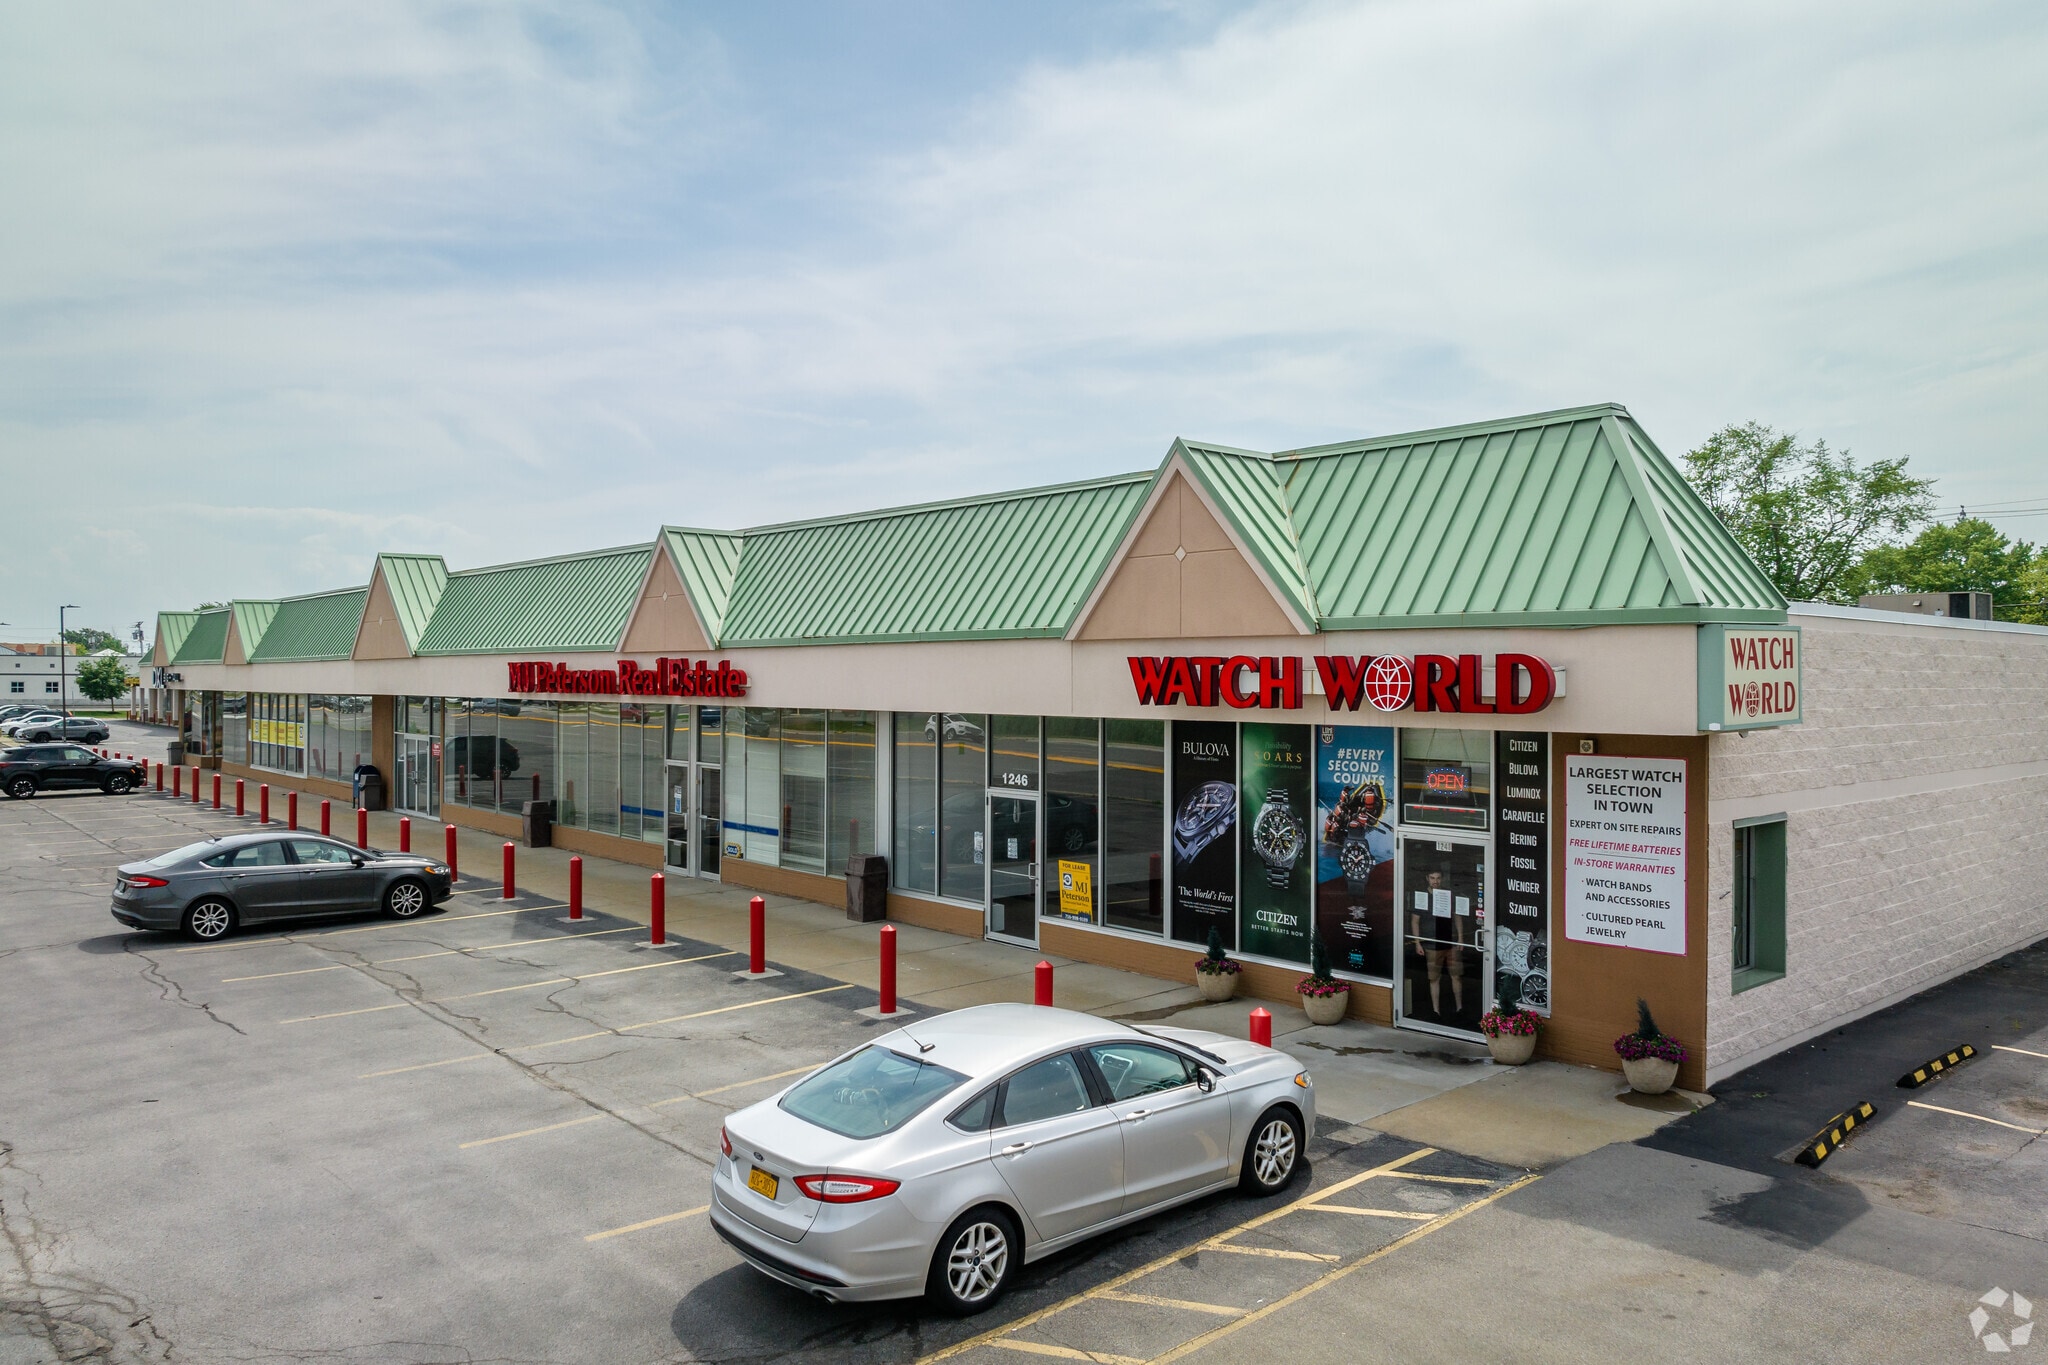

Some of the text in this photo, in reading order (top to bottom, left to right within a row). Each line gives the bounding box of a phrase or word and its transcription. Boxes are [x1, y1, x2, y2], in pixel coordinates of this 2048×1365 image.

[1730, 637, 1793, 670] WATCH
[536, 662, 616, 693] Peterson
[617, 657, 668, 695] Real
[668, 658, 747, 697] Estate
[1127, 654, 1556, 714] WATCH WORLD
[1728, 681, 1796, 717] WORLD
[1183, 741, 1229, 756] BULOVA
[1338, 748, 1384, 760] #EVERY
[1254, 751, 1302, 763] SOARS
[1328, 760, 1379, 773] SECOND
[1002, 772, 1028, 786] 1246
[1333, 772, 1385, 786] COUNTS
[1428, 773, 1464, 789] OPEN
[1569, 767, 1682, 783] LARGEST WATCH
[1587, 783, 1662, 798] SELECTION
[1594, 800, 1653, 814] IN TOWN
[1569, 819, 1681, 835] EXPERT ON SITE REPAIRS
[1569, 838, 1682, 856] FREE LIFETIME BATTERIES
[1574, 857, 1676, 875] IN-STORE WARRANTIES
[1075, 881, 1088, 894] MJ
[1586, 878, 1652, 893] WATCH BANDS
[1062, 890, 1090, 903] Peterson
[1178, 885, 1233, 902] The World's First
[1585, 892, 1671, 910] AND ACCESSORIES
[1256, 909, 1298, 926] CITIZEN
[1586, 912, 1666, 930] CULTURED PEARL
[1270, 927, 1289, 935] STARTS
[1585, 926, 1627, 939] JEWELRY
